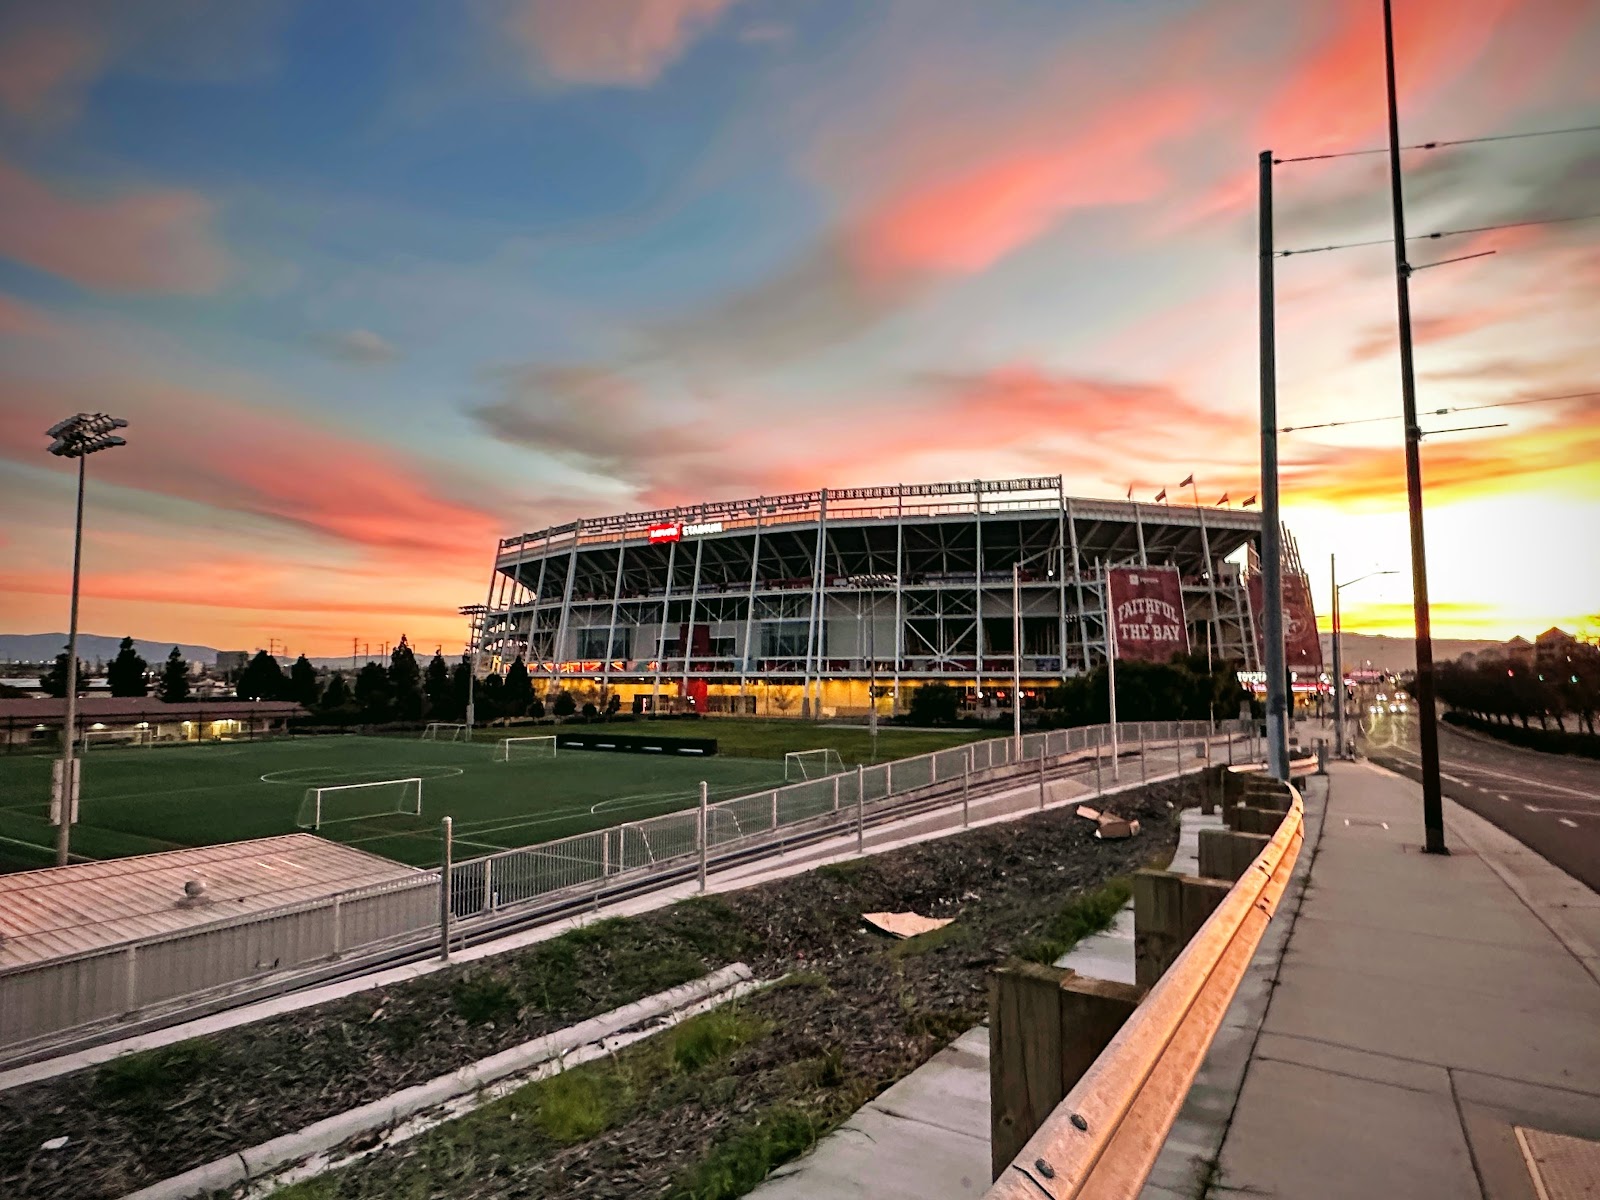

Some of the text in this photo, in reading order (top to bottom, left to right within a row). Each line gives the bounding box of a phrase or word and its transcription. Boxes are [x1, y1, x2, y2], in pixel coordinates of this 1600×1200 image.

[682, 523, 722, 536] STADIUM
[1117, 597, 1180, 624] FAITHFUL
[1119, 624, 1181, 641] THE BAY
